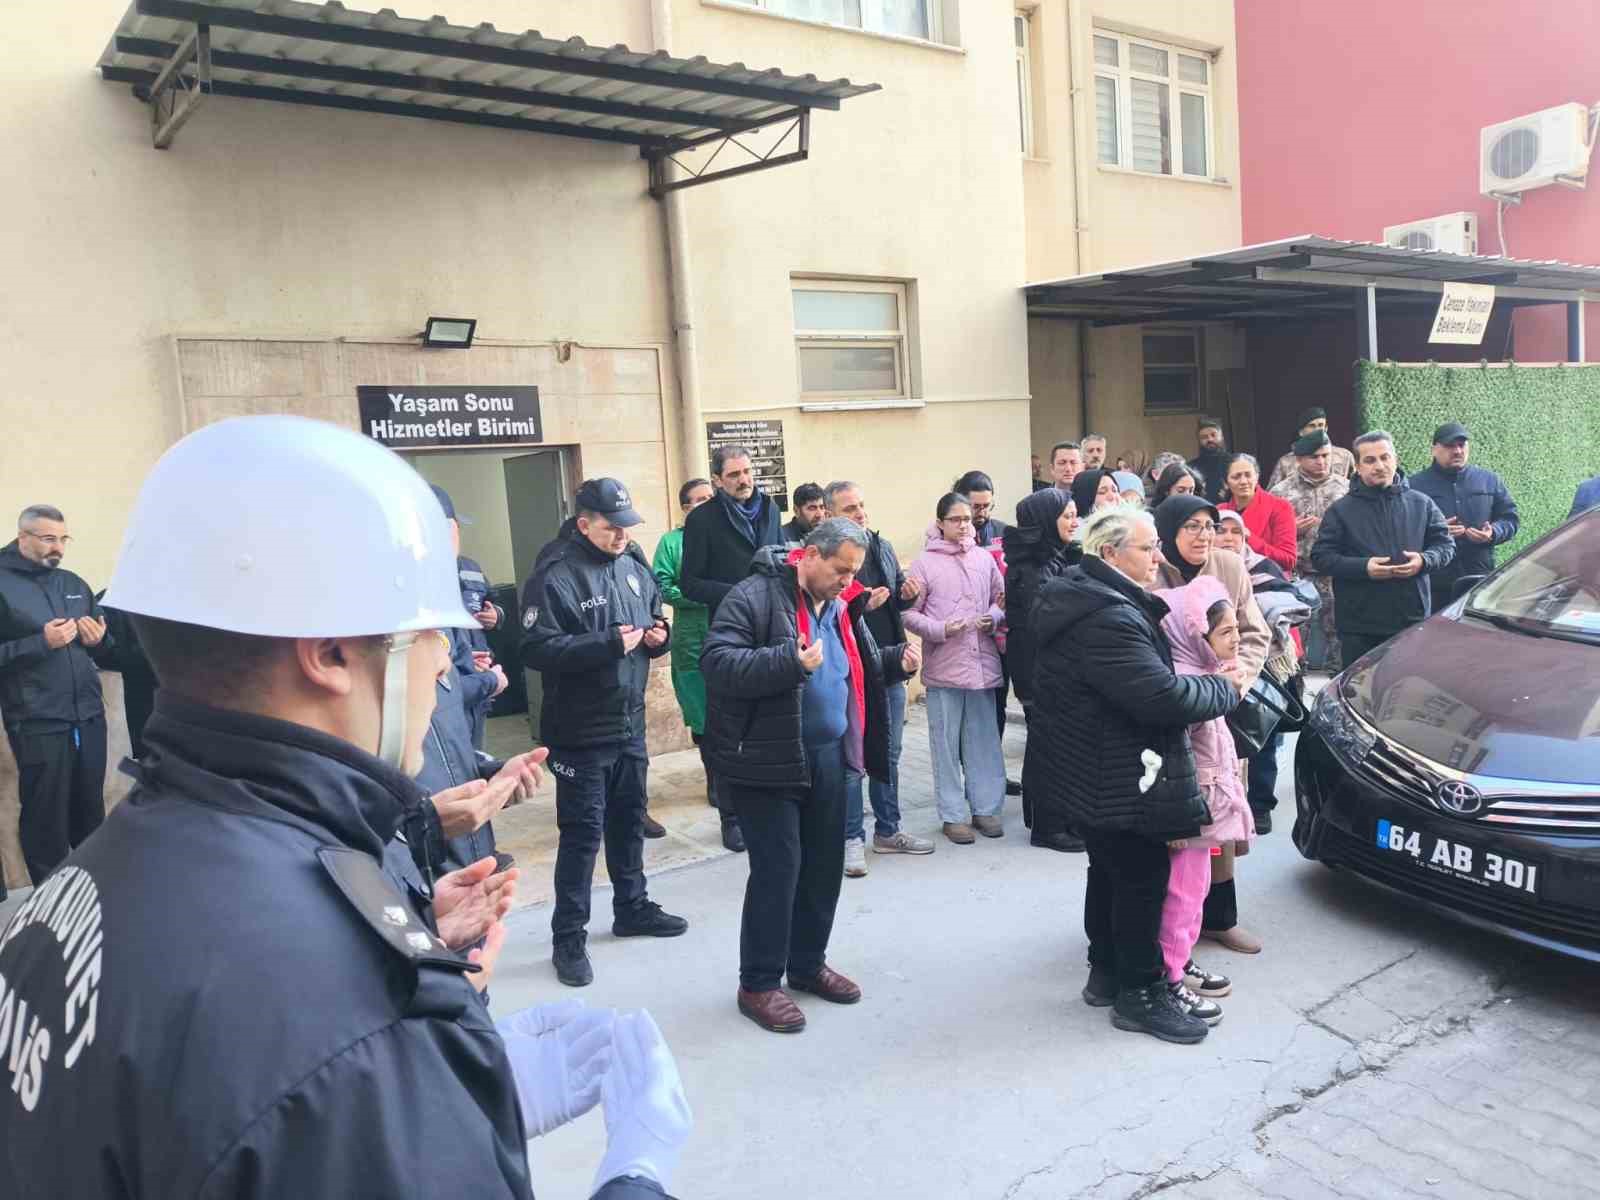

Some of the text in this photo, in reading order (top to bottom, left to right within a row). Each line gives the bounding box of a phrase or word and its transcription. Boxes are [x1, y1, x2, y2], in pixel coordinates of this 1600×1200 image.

[388, 393, 514, 417] Yaşam Sonu
[370, 417, 535, 439] Hizmetler Birimi
[1389, 824, 1422, 858] 64
[1430, 838, 1473, 873] AB
[1483, 852, 1537, 894] 301
